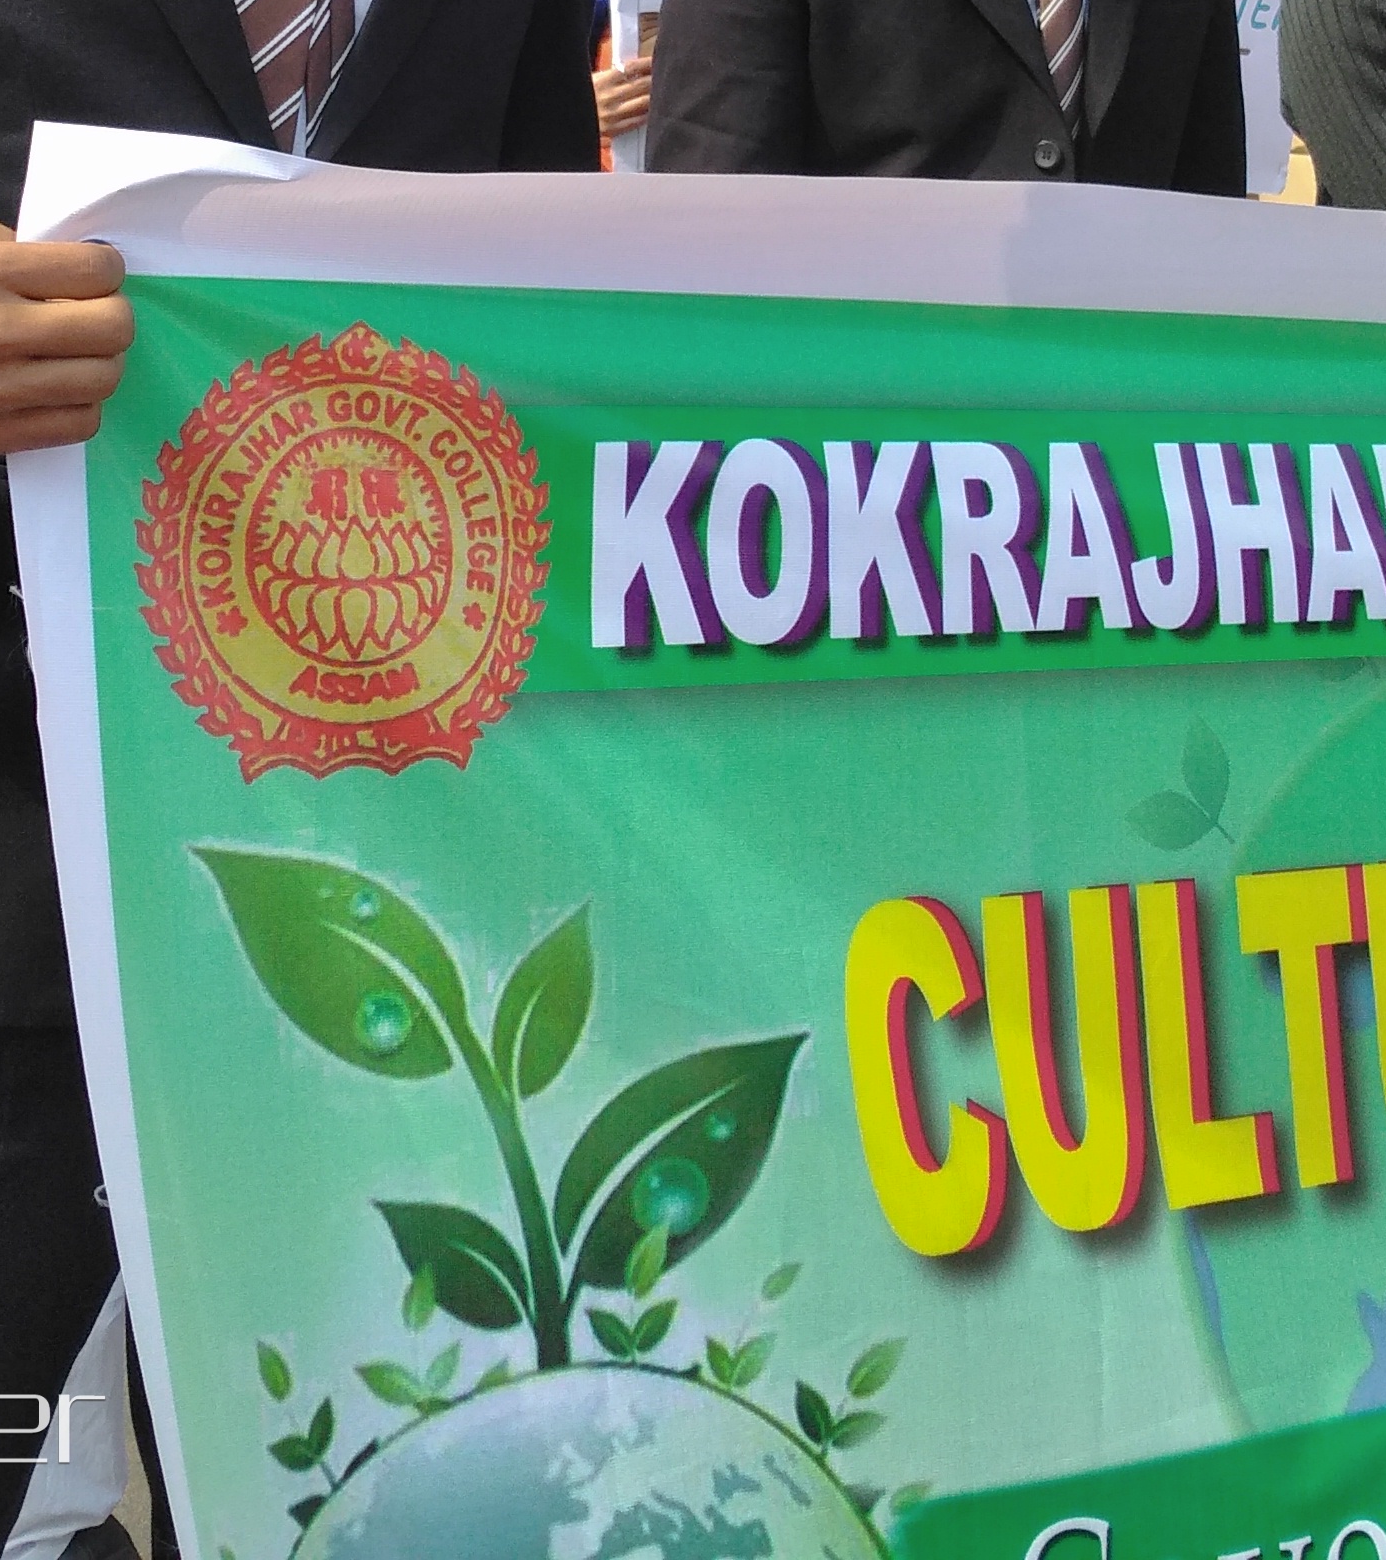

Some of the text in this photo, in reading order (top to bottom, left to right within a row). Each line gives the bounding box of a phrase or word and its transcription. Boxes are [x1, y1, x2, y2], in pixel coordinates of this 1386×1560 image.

[197, 390, 498, 608] KOKRAJHAR GOVT. COLLEGE
